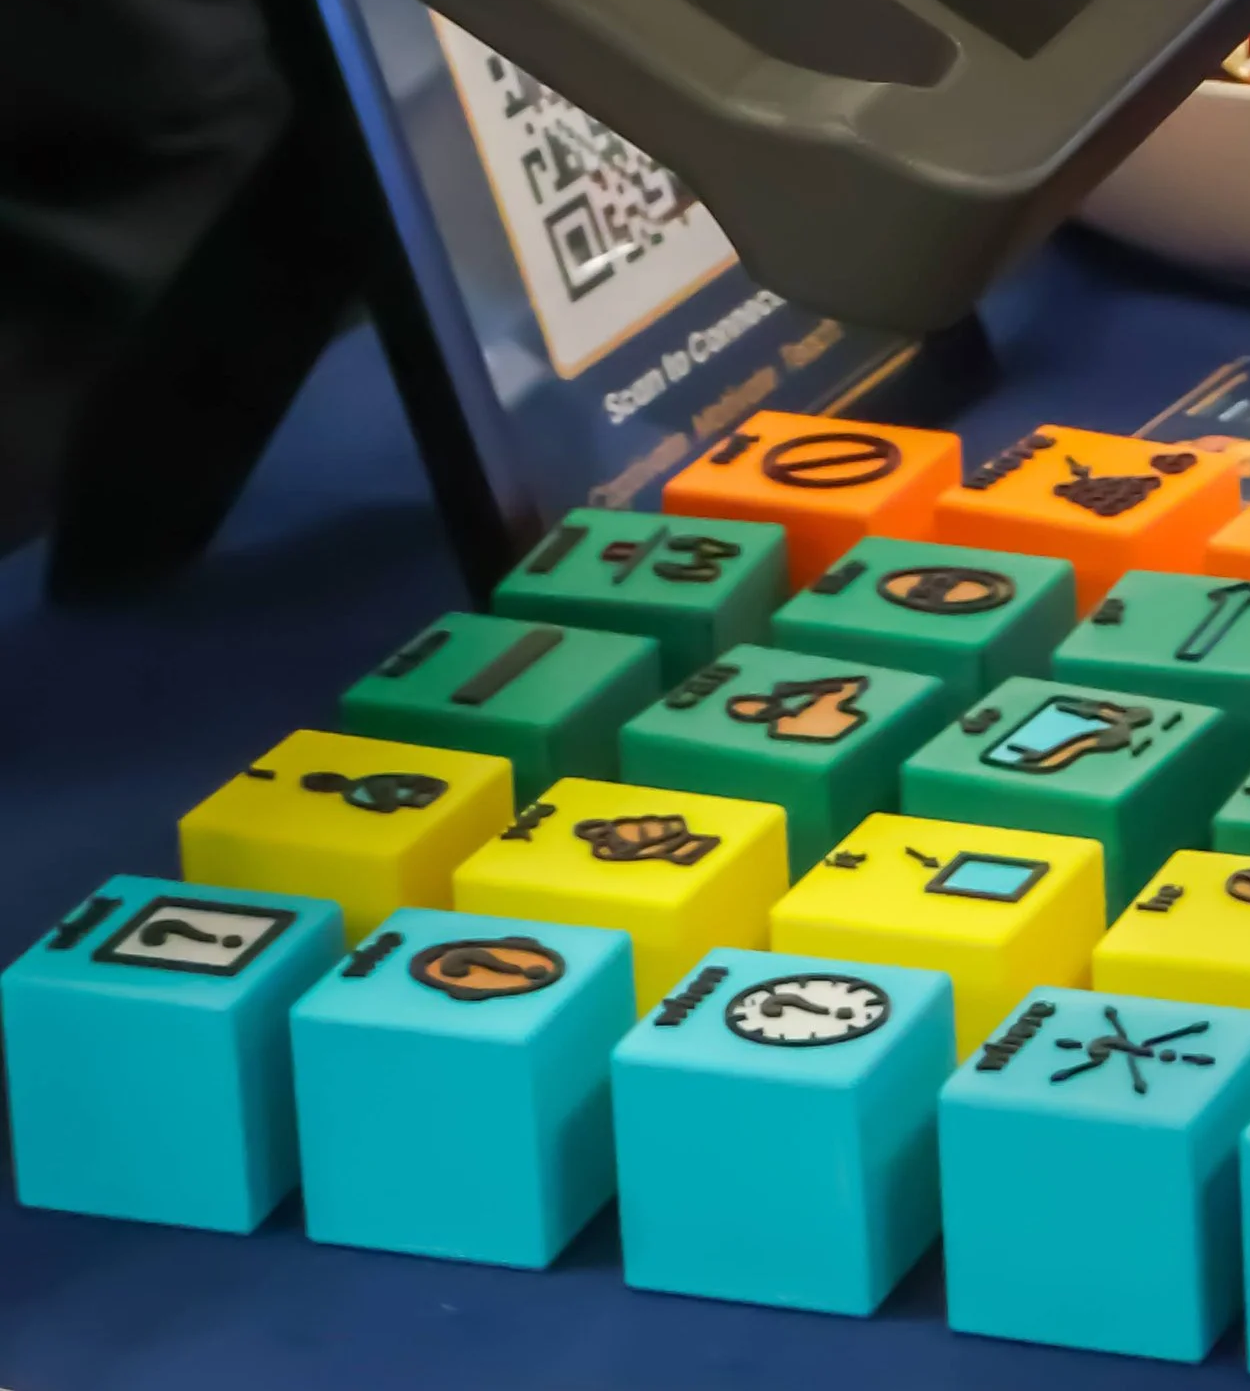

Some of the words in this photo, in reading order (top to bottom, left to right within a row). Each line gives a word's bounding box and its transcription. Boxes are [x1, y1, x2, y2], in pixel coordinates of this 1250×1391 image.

[604, 368, 667, 425] Scan
[1136, 884, 1183, 912] he
[655, 966, 728, 1026] when
[976, 1000, 1056, 1071] where
